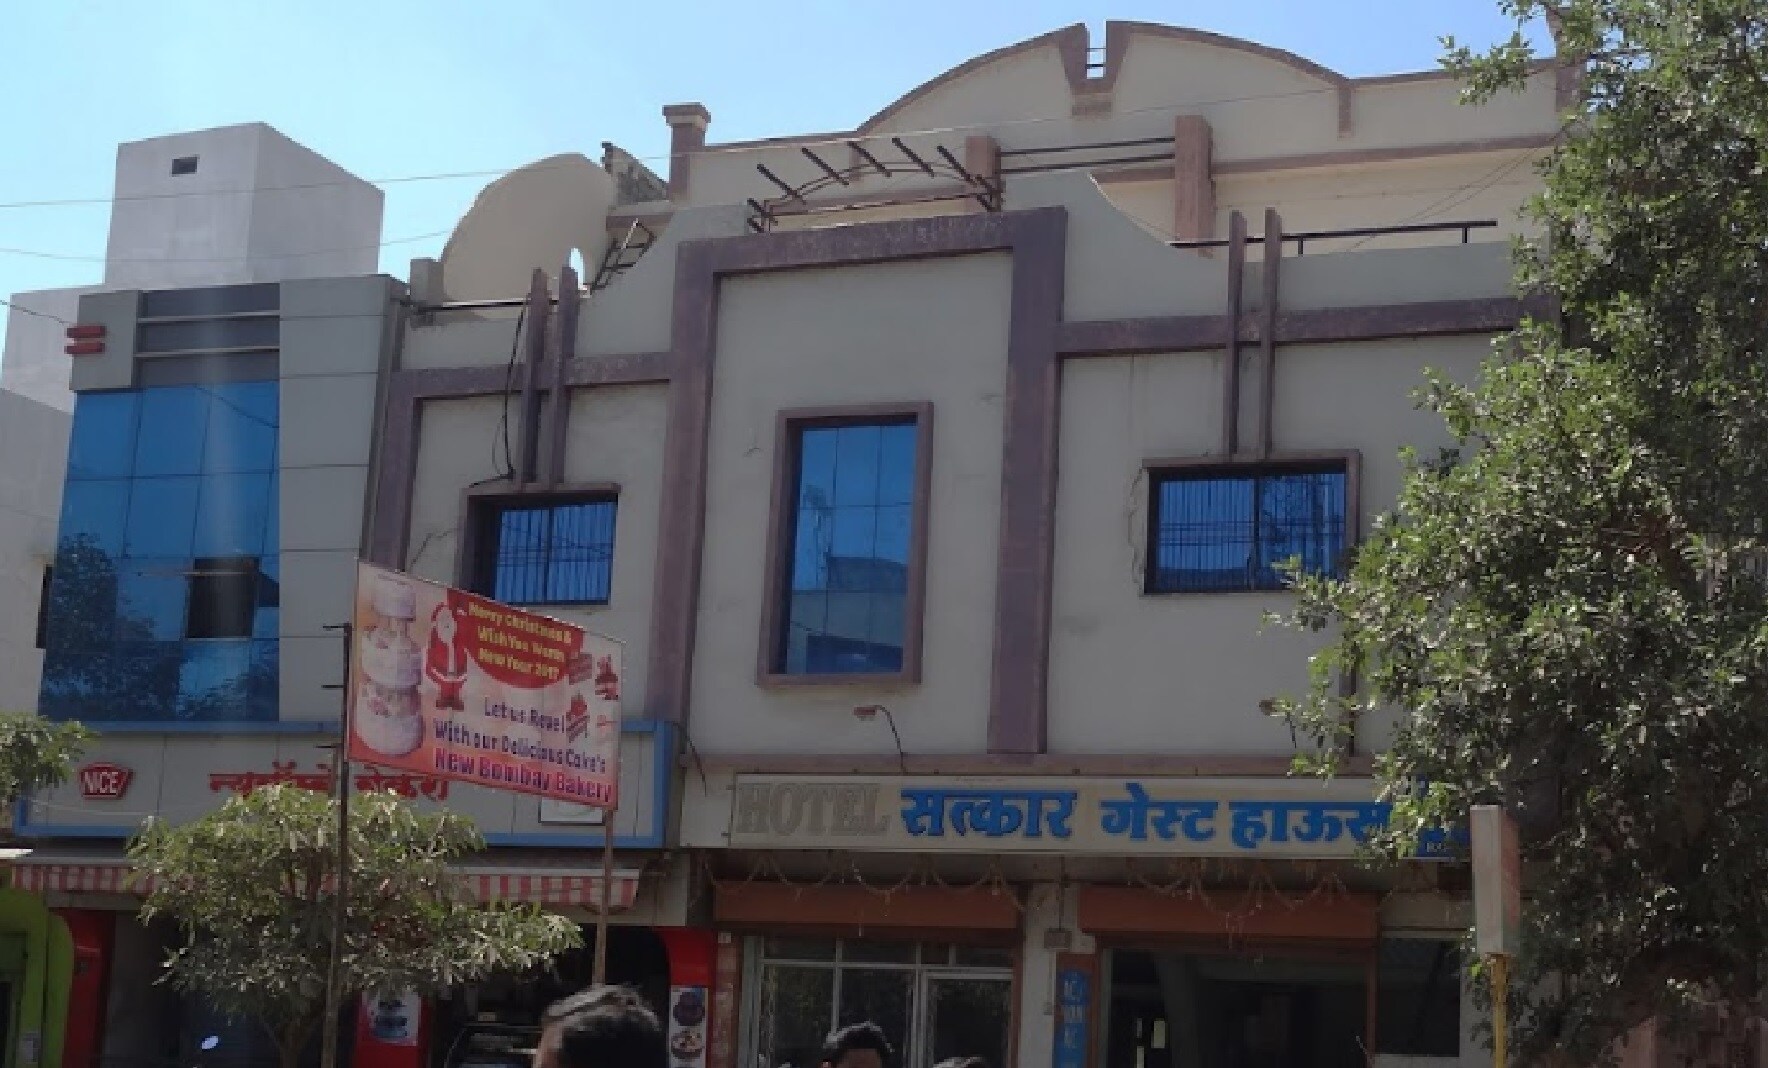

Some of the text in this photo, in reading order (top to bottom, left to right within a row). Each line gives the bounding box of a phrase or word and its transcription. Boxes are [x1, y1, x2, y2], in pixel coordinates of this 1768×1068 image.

[469, 603, 502, 626] Merry
[506, 616, 562, 642] Christmas
[479, 627, 507, 646] Wish
[509, 634, 529, 652] You
[480, 649, 506, 666] New
[508, 654, 532, 672] Year
[486, 698, 508, 719] Let
[434, 719, 606, 773] With our Delicious Cake's
[84, 771, 119, 794] NICE
[434, 747, 612, 803] New Bombay Bakery
[736, 782, 892, 837] HOTEL
[900, 788, 1078, 839] सत्कार
[1101, 782, 1219, 841] गेस्ट
